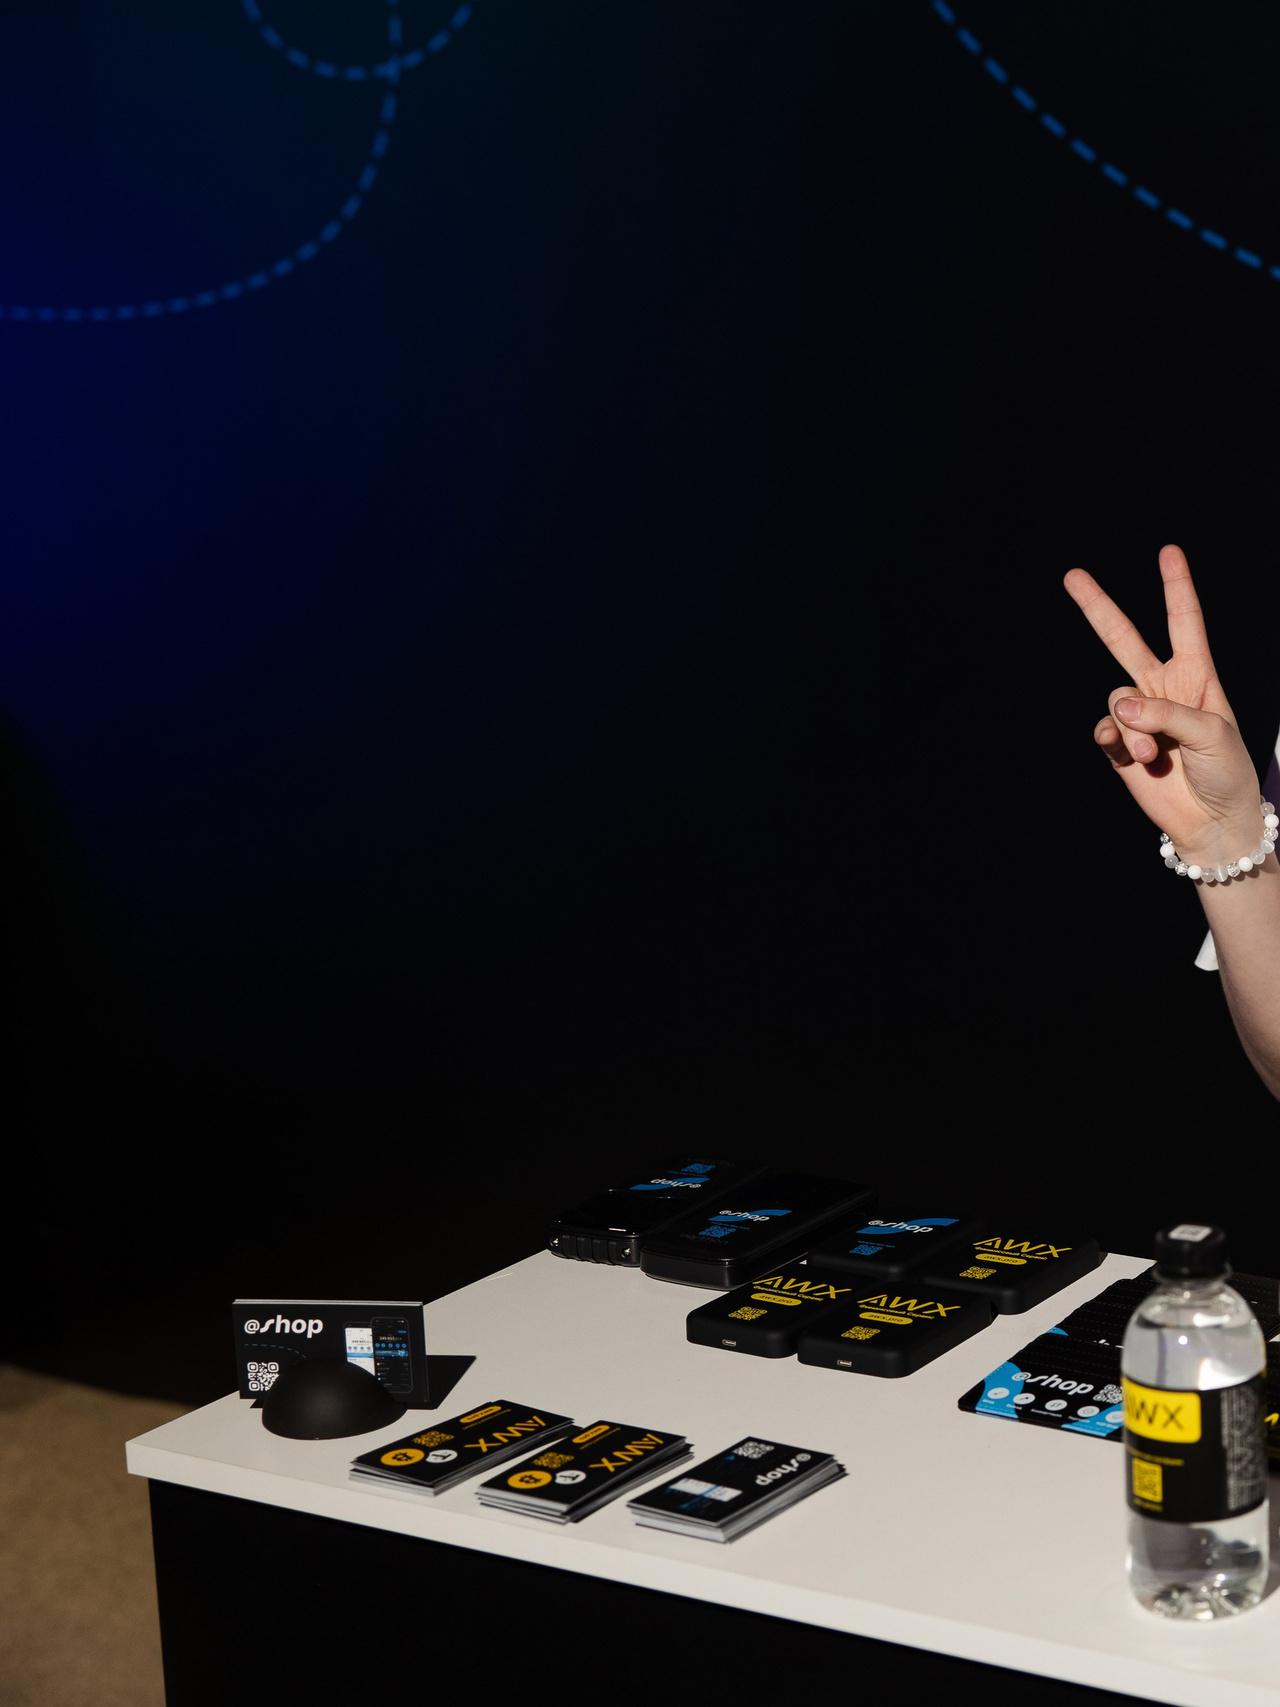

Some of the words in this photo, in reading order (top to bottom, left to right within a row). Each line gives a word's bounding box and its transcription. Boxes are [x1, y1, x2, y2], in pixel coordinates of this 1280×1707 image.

[868, 1220, 934, 1233] @shop
[972, 1236, 1073, 1258] AWX
[752, 1275, 853, 1300] AWX
[856, 1293, 962, 1317] AWX
[244, 1314, 324, 1339] @shop
[1010, 1371, 1094, 1396] @shop
[463, 1415, 547, 1453] AWX
[588, 1433, 664, 1473] AWX
[755, 1453, 812, 1486] @shop
